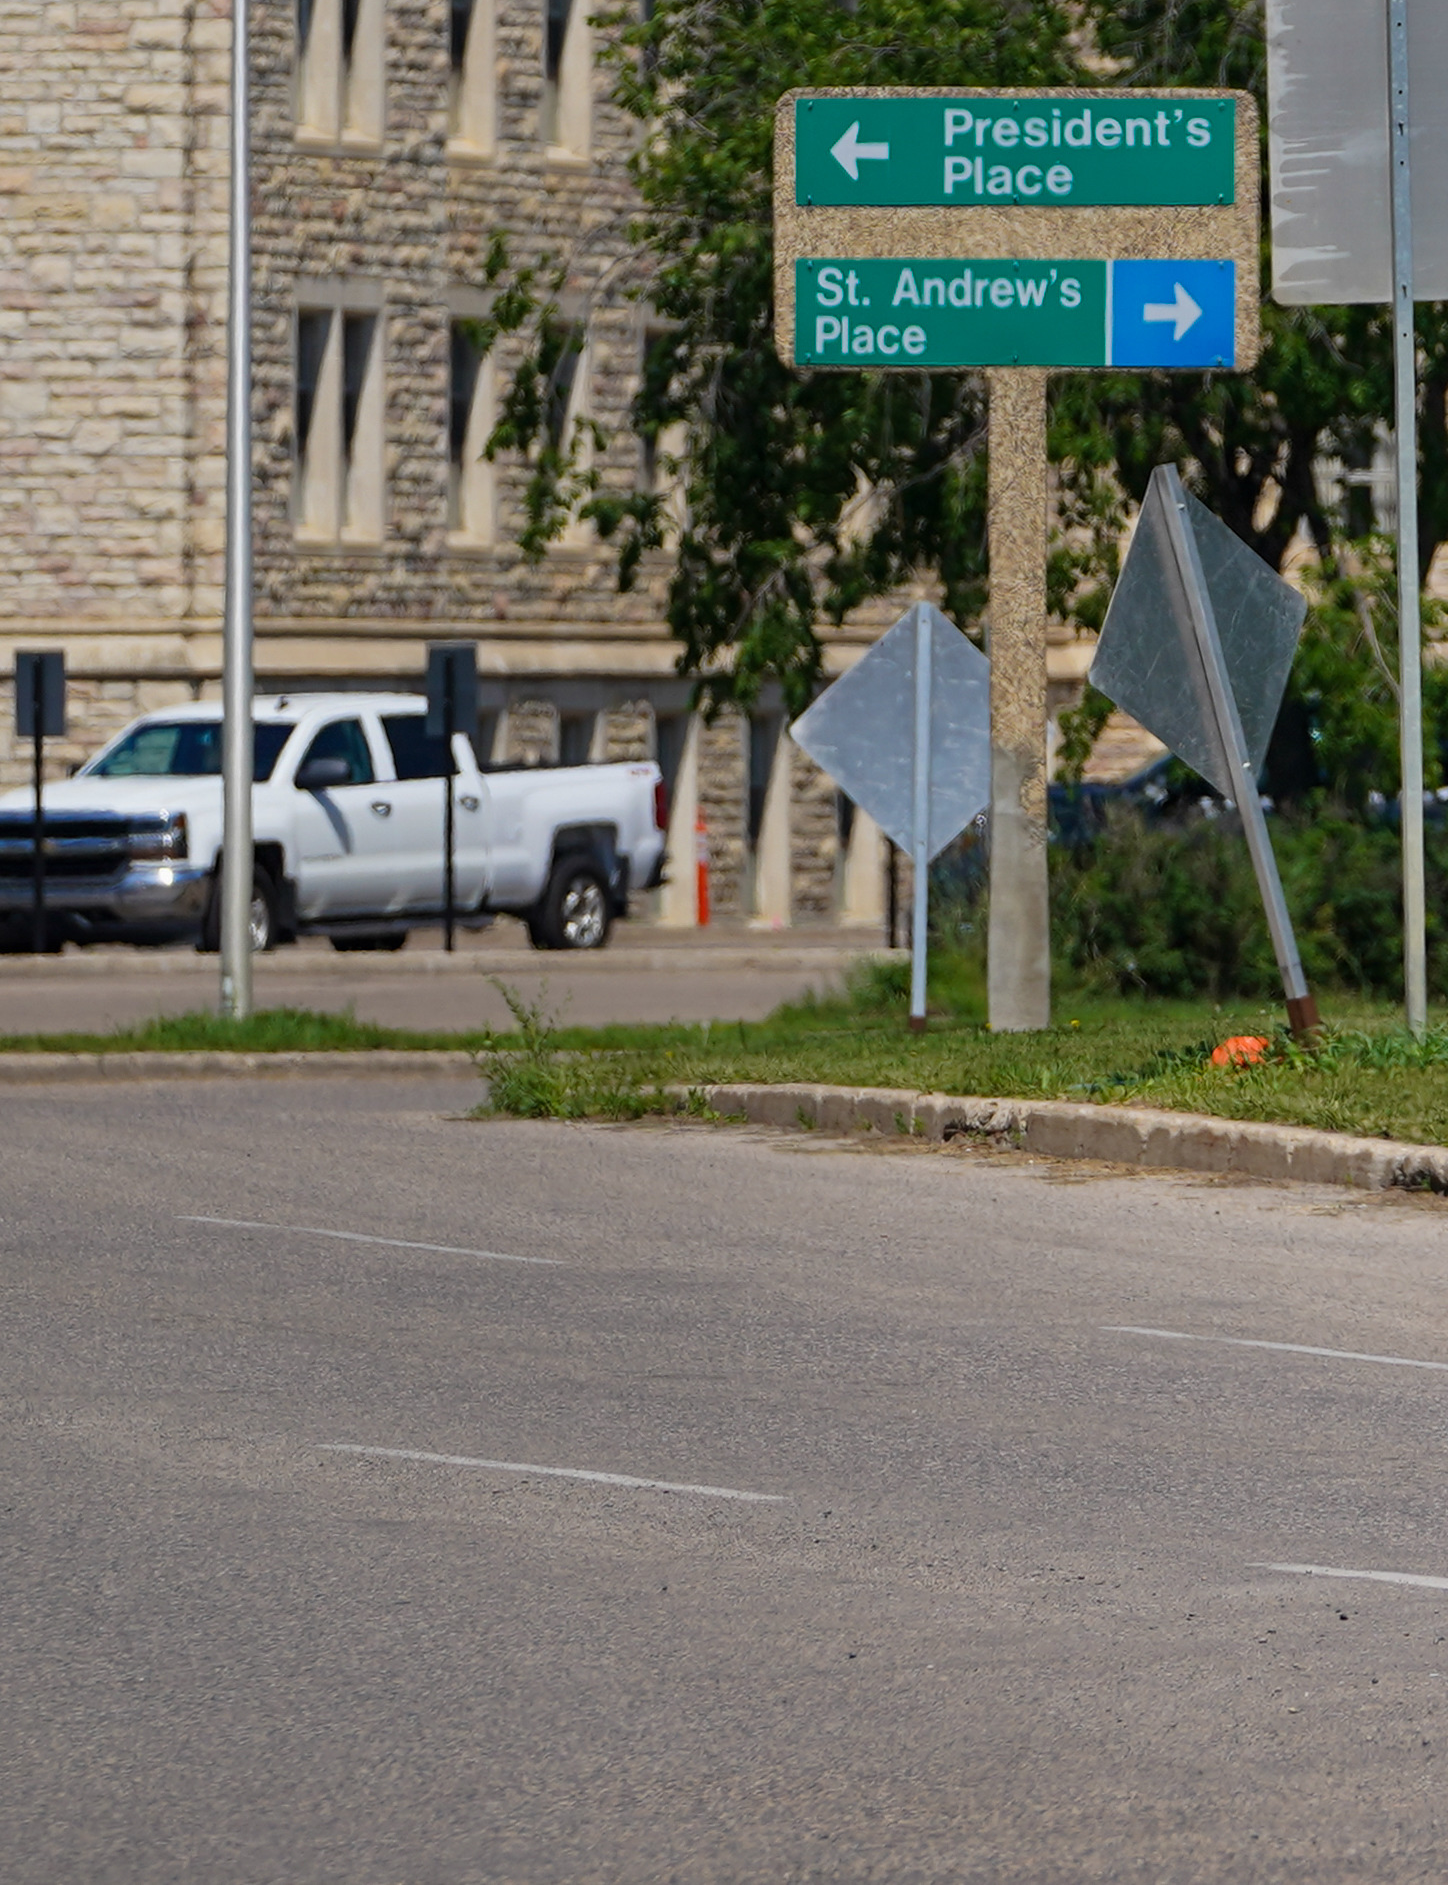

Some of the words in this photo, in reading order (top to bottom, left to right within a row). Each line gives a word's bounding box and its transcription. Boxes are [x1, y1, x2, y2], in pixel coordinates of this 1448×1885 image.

[943, 107, 1213, 148] President's
[943, 156, 1074, 195] Place
[816, 267, 871, 308] St.
[892, 268, 1083, 308] Andrew's
[815, 315, 928, 355] Place
